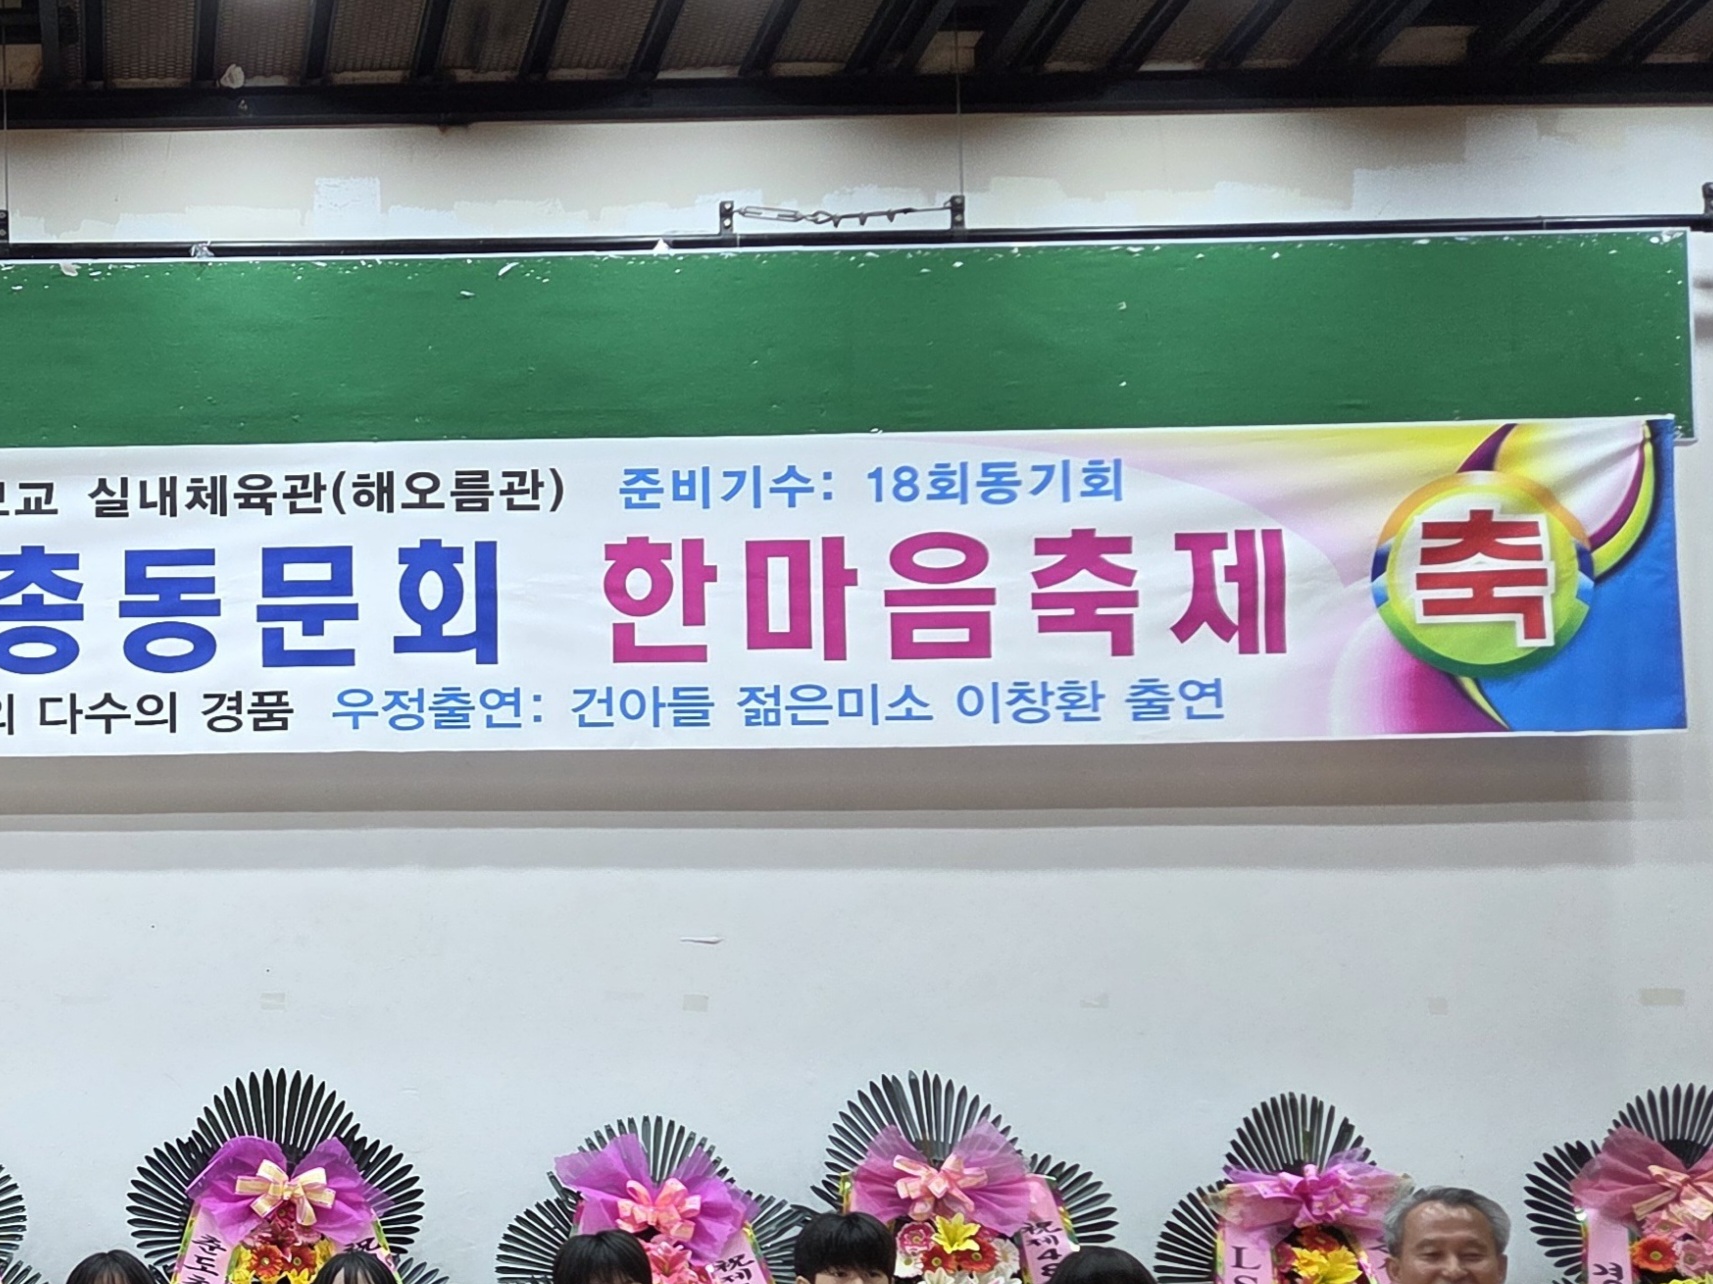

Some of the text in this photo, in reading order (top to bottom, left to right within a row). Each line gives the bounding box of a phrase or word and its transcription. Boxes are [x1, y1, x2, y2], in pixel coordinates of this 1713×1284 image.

[87, 467, 565, 519] 실내체육관(해오름관)
[619, 464, 833, 509] 준비기수:
[867, 458, 1124, 506] 18회동기회
[603, 527, 1287, 664] 한마음축제
[1416, 509, 1548, 640] 축
[39, 691, 177, 735] 다수의
[201, 690, 295, 733] 경품
[332, 686, 543, 731] 우정출연:
[571, 685, 715, 729] 건아들
[737, 683, 934, 727] 젊은미소
[956, 679, 1106, 725] 이창환
[1124, 677, 1225, 722] 출연
